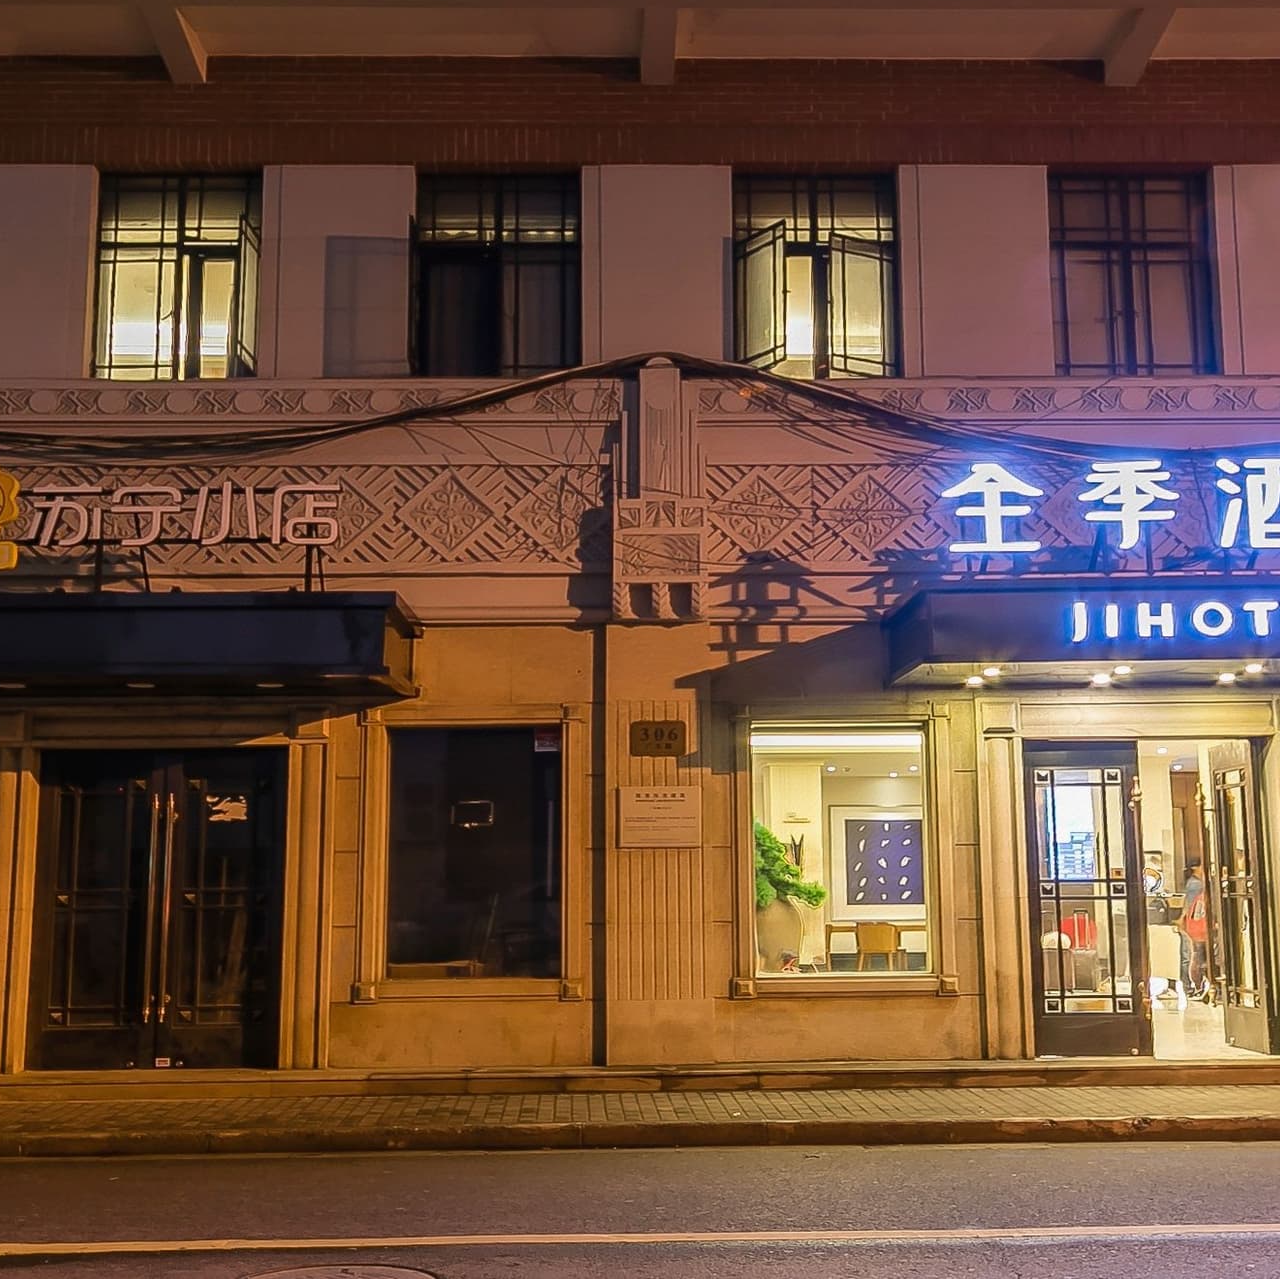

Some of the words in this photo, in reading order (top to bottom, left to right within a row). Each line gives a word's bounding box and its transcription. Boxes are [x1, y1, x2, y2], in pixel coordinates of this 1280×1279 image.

[26, 481, 342, 547] 苏宁小店
[639, 727, 679, 742] 306
